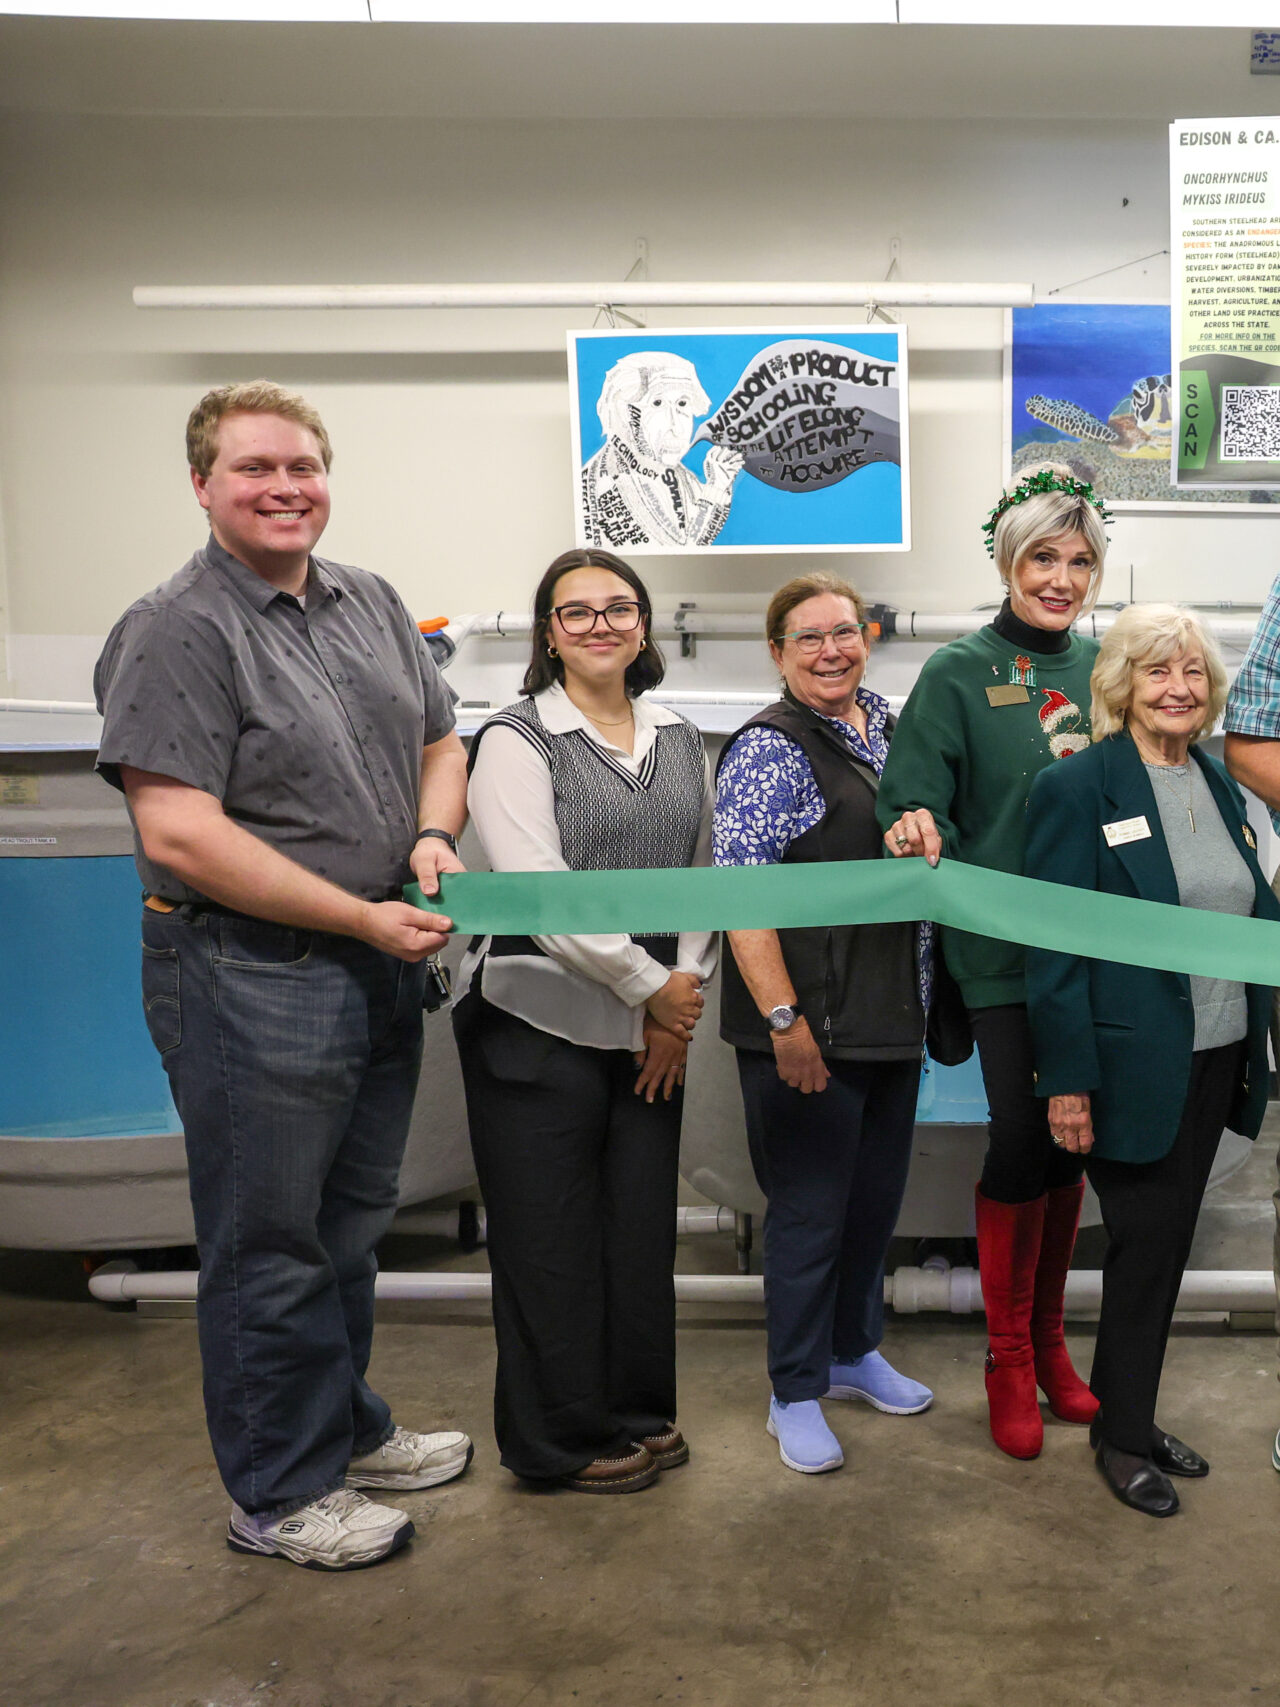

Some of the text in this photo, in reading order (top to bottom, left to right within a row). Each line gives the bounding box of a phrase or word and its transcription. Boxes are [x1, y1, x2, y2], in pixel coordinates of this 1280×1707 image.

[1179, 131, 1231, 146] EDISON
[1238, 131, 1248, 144] &
[1254, 130, 1279, 144] CA.
[1184, 171, 1268, 185] ONCORHYNCHUS
[1182, 192, 1266, 206] MYKISS IRIDEUS
[768, 355, 782, 367] IS
[780, 370, 787, 380] A
[788, 349, 896, 387] PRODUCT
[712, 432, 724, 442] OF
[1184, 383, 1200, 457] SCAN
[611, 435, 659, 480] TECHNOLOGY
[774, 425, 874, 463] ATTEMPT
[760, 466, 775, 477] TO
[581, 467, 593, 540] EFFECT IDEA
[600, 494, 614, 519] PAID
[617, 531, 630, 544] IS
[606, 489, 624, 518] PRICE
[620, 518, 630, 529] TO
[626, 529, 642, 546] BE
[615, 493, 634, 522] THERE
[632, 523, 641, 532] IS
[639, 531, 650, 544] NO
